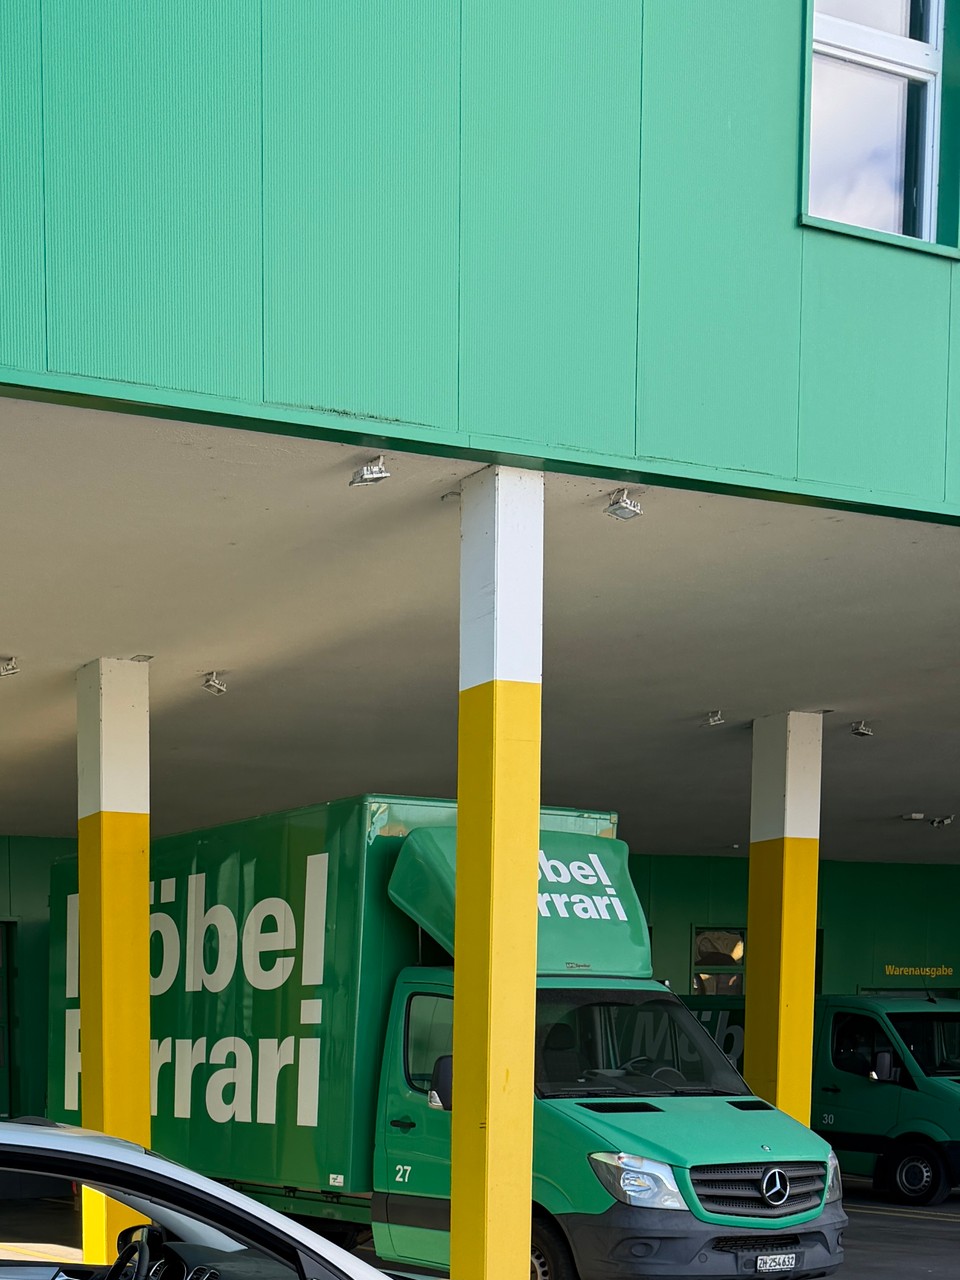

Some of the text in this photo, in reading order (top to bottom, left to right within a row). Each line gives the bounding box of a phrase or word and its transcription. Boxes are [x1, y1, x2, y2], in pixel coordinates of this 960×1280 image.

[66, 852, 329, 998] öbel
[885, 964, 953, 978] Warenausgabe
[822, 1113, 835, 1125] 30
[395, 1164, 412, 1183] 27
